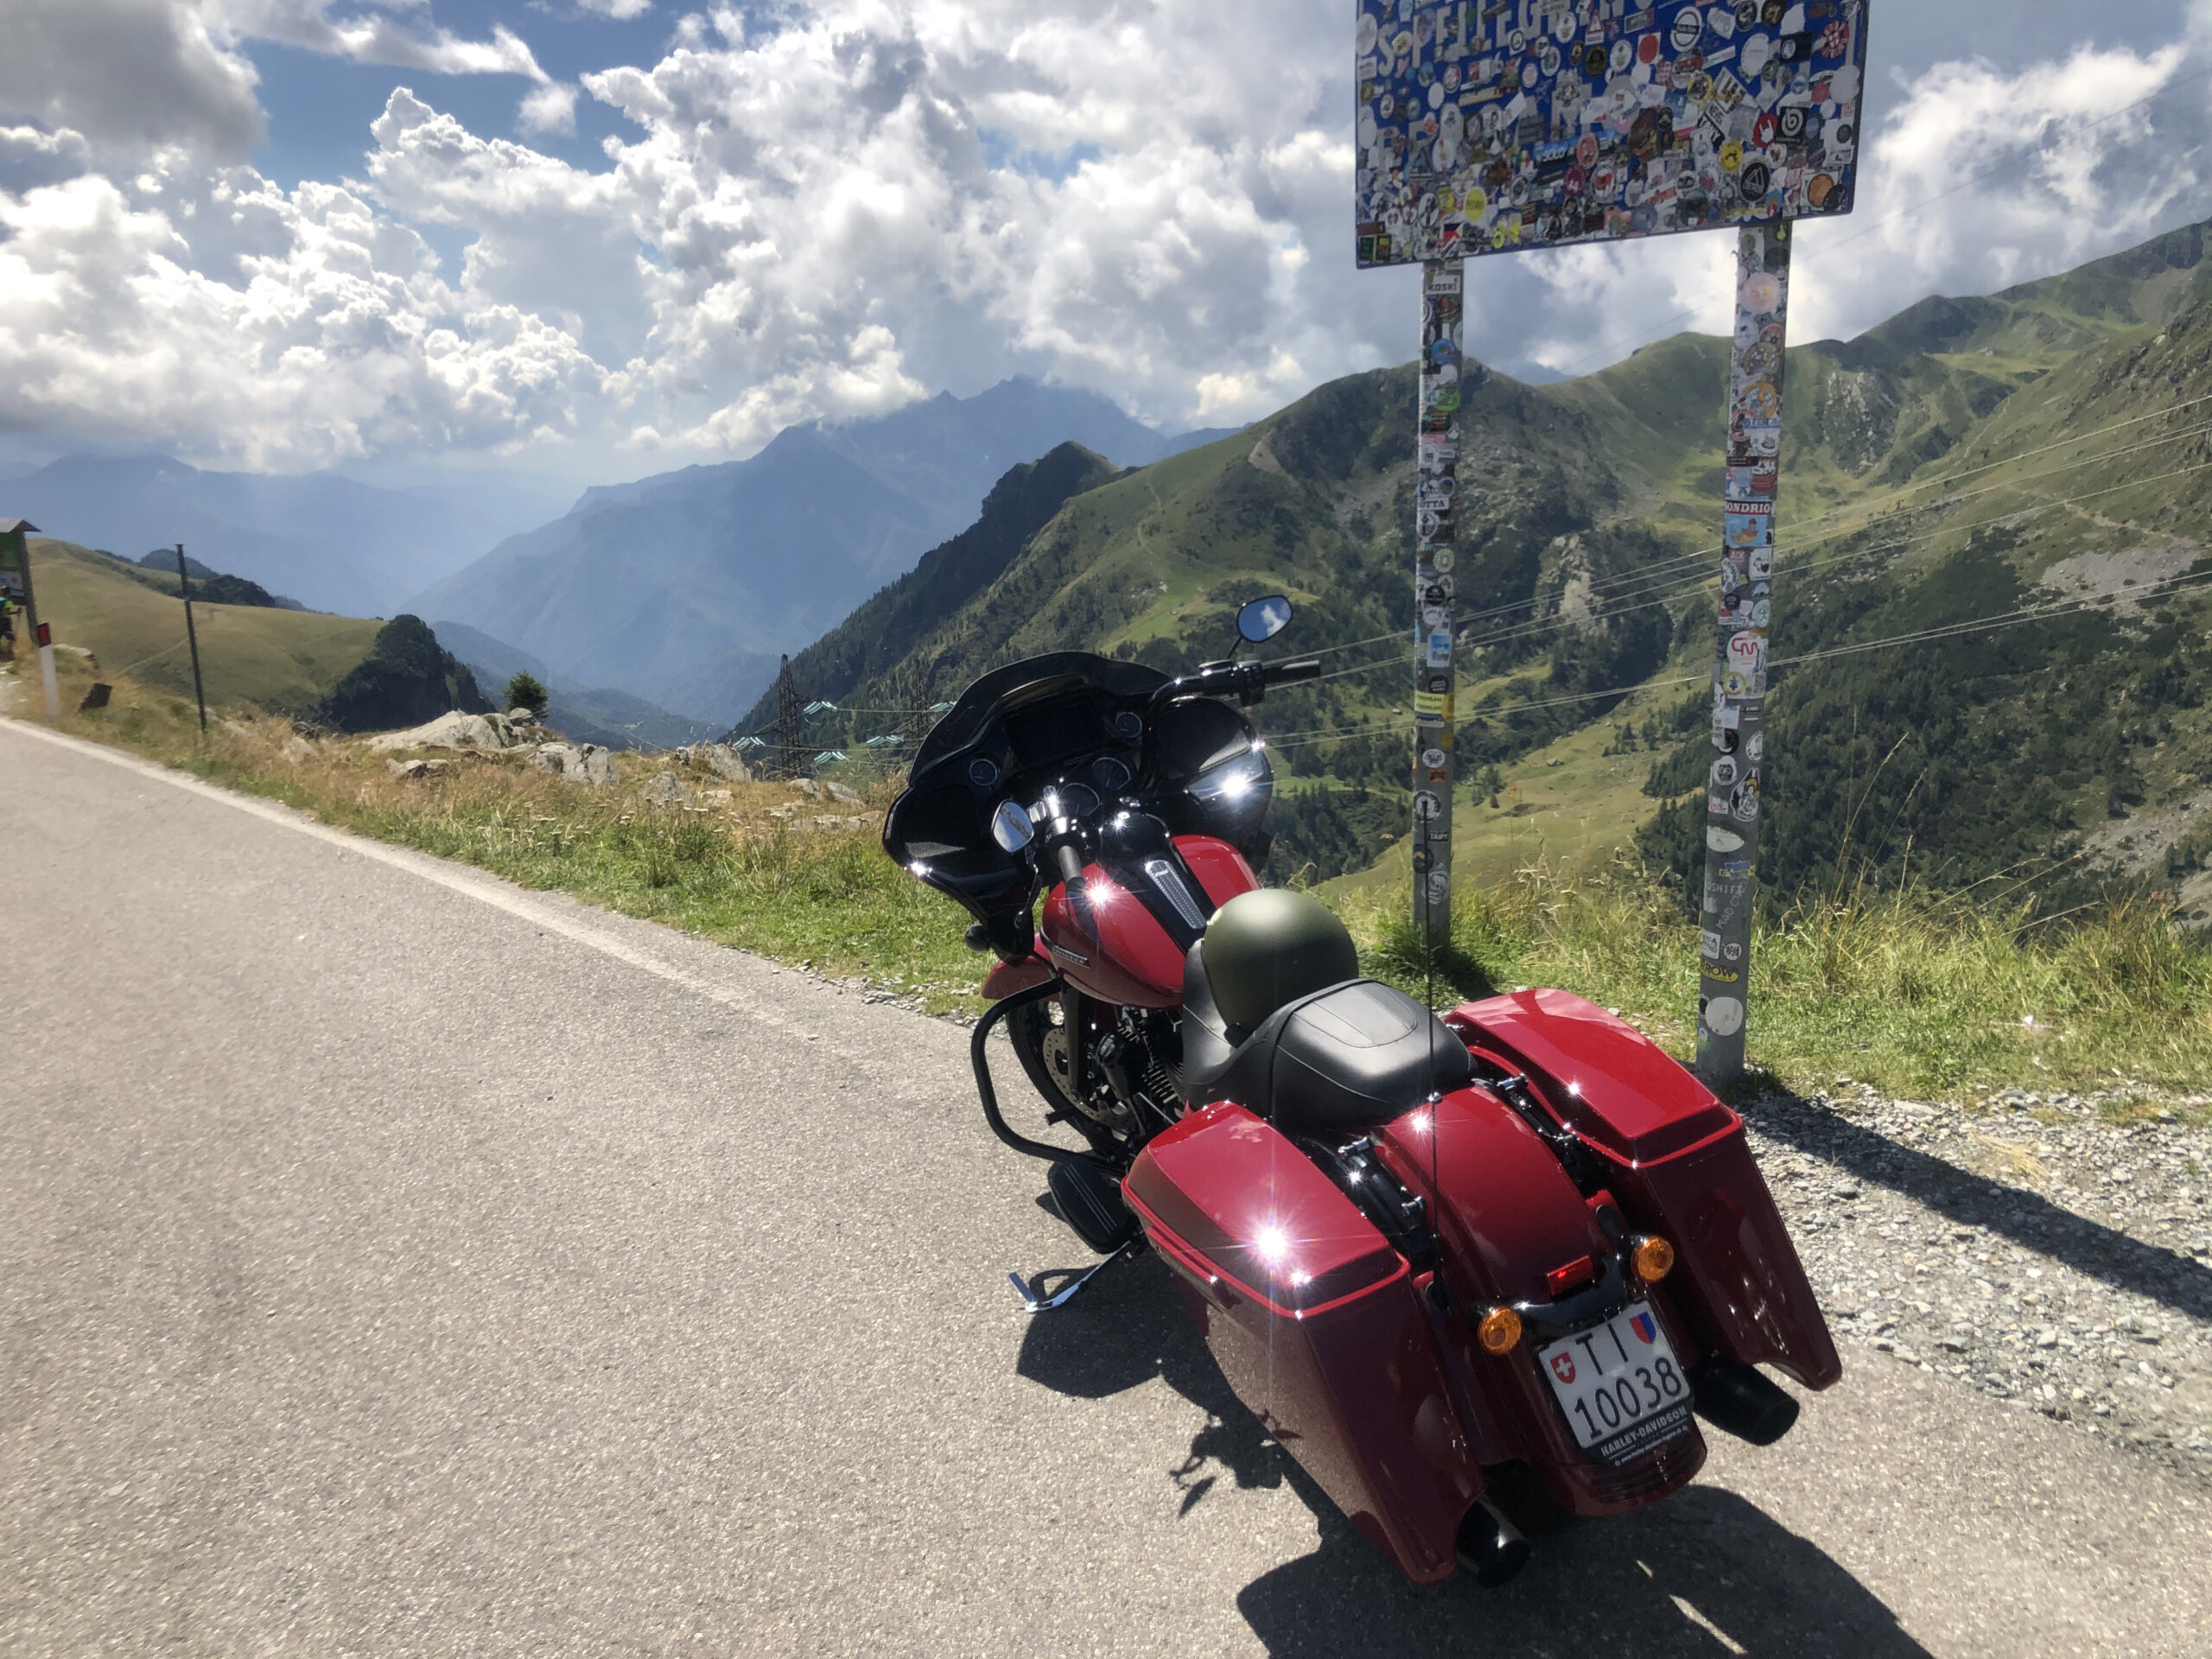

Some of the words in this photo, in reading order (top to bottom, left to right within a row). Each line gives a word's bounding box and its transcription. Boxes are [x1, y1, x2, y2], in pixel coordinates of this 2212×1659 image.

[1575, 1324, 1628, 1376] TI
[1574, 1357, 1682, 1440] 10038
[1600, 1406, 1688, 1457] HARLEY-DAVIDSON
